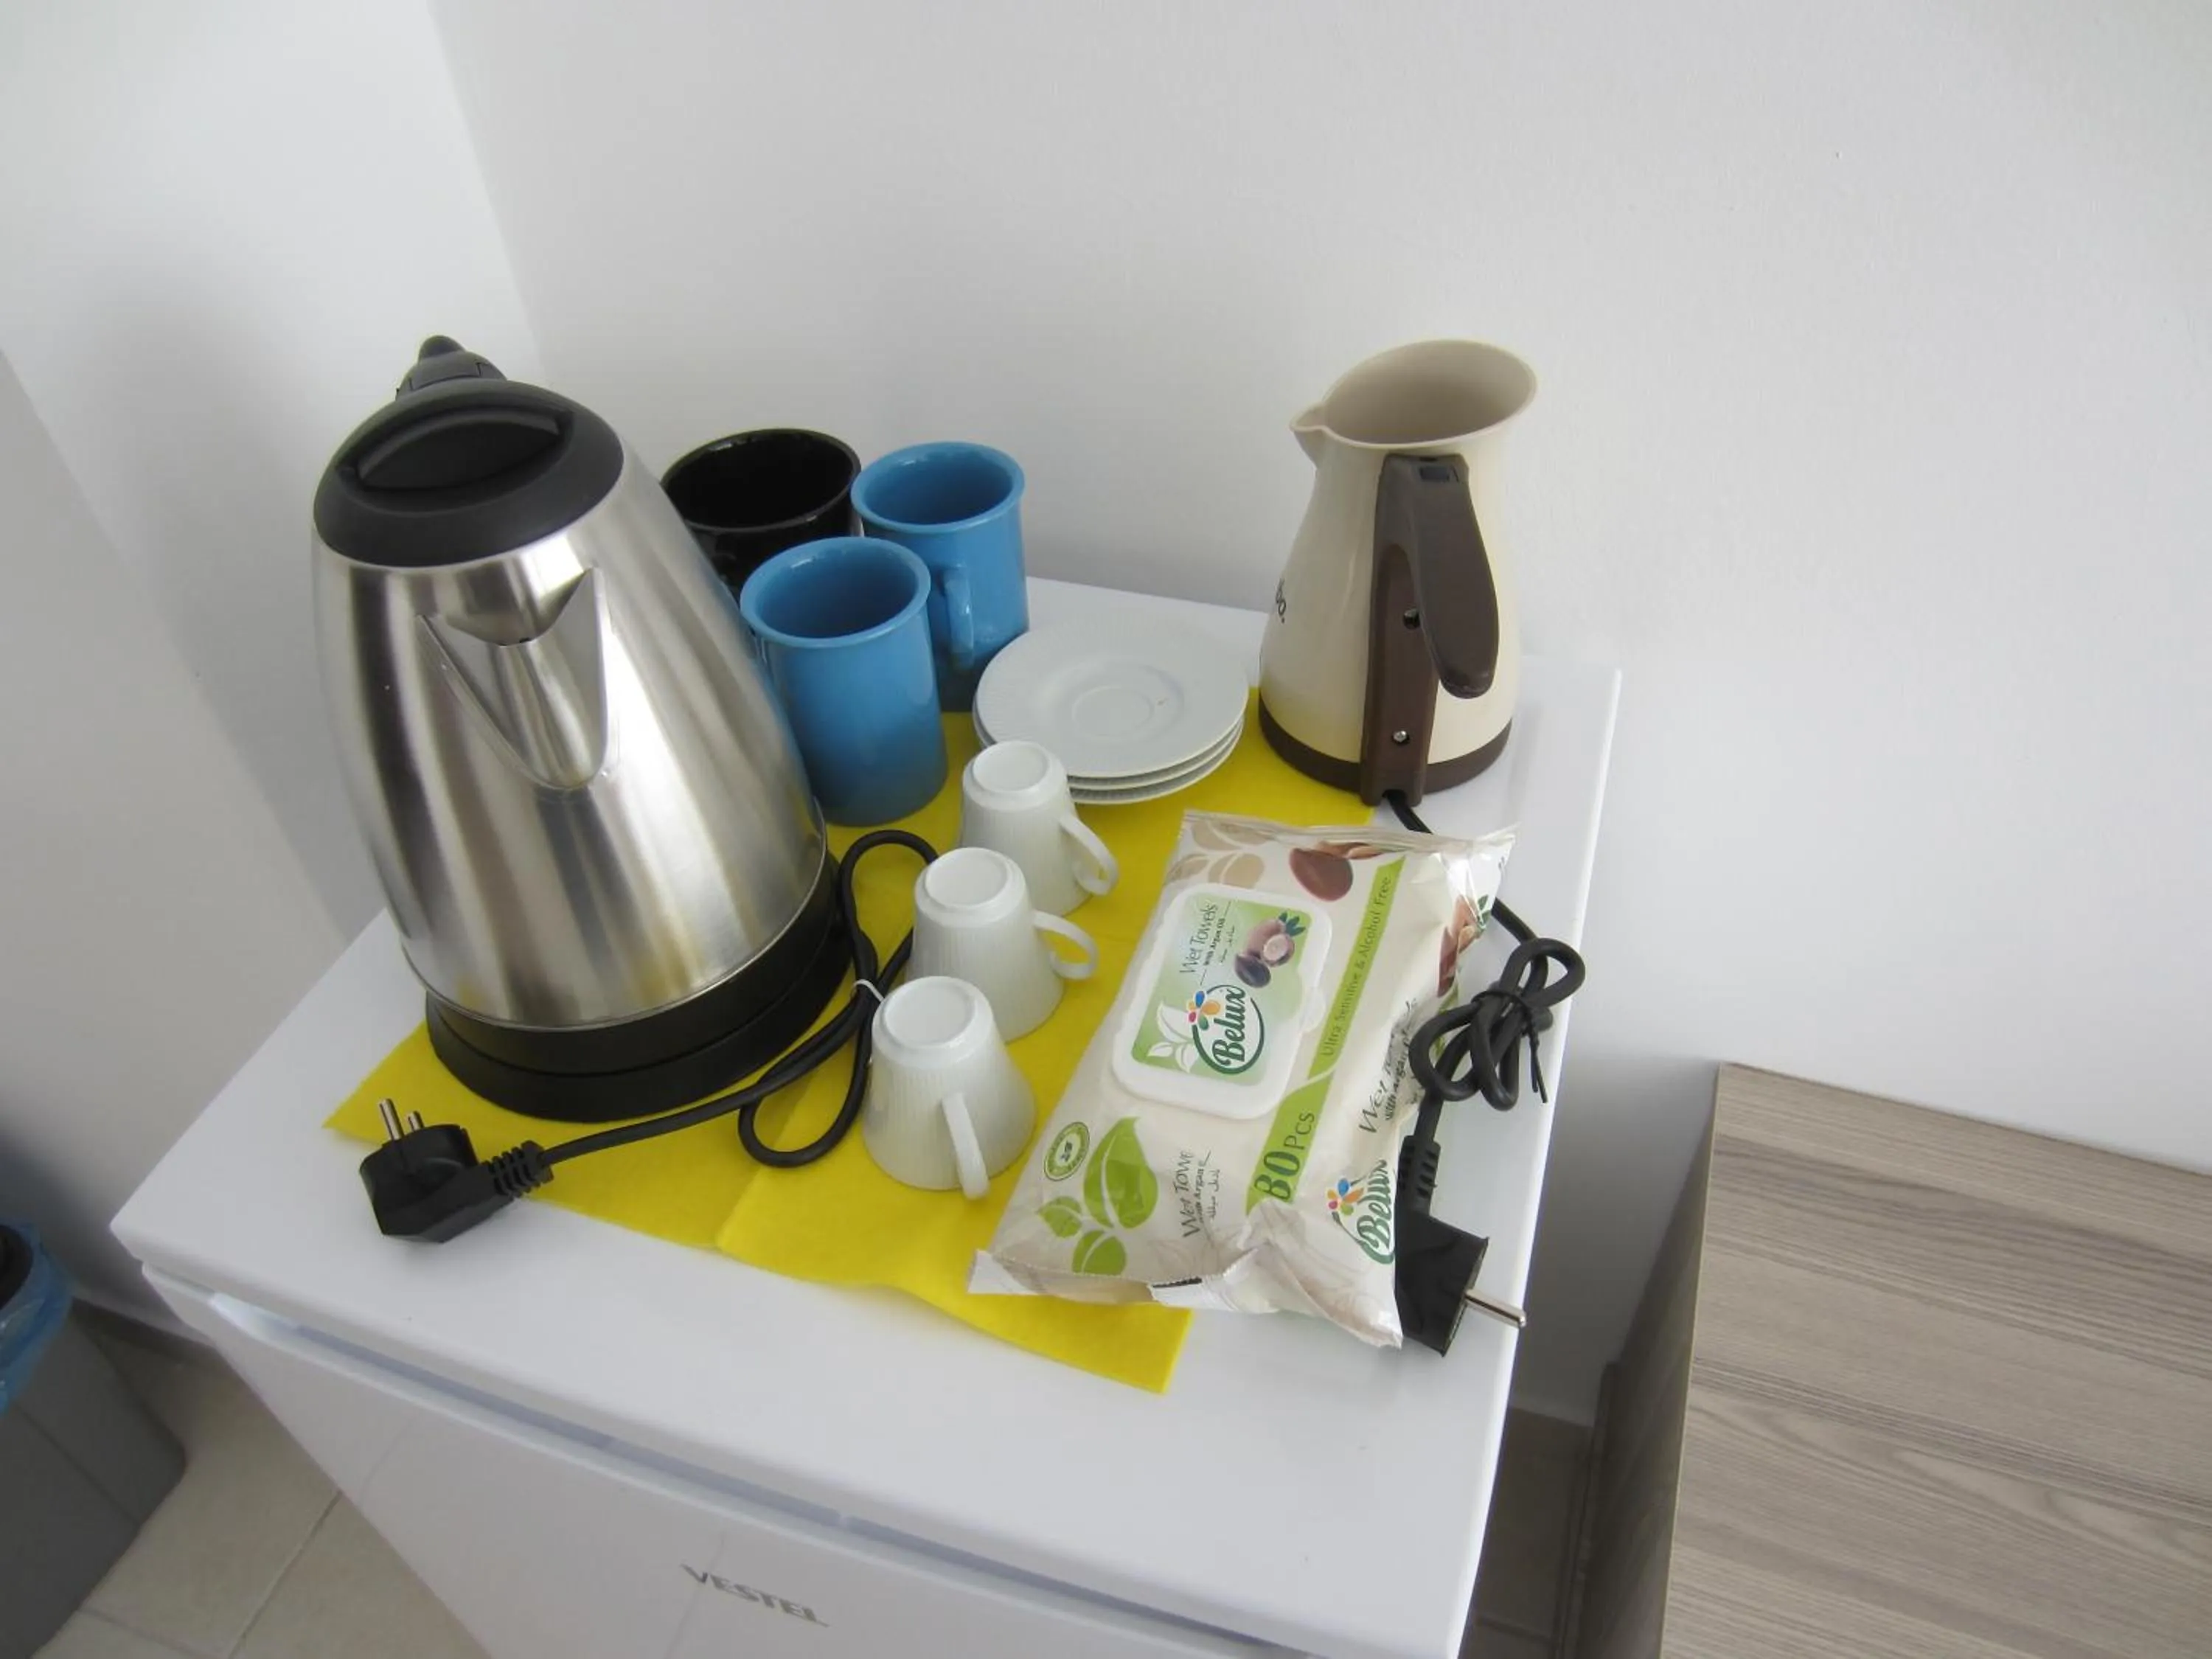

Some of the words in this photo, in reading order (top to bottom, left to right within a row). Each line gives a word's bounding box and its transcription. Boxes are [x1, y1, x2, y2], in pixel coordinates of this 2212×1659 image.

[1189, 902, 1218, 945] Towels
[1319, 1026, 1341, 1056] Ultra
[1357, 911, 1381, 958] Alcohol
[1373, 876, 1391, 906] Free
[1211, 988, 1245, 1066] Belux
[1358, 1079, 1389, 1133] Wet
[1253, 1151, 1301, 1202] 80
[1283, 1113, 1315, 1150] Pcs
[1180, 1197, 1200, 1238] Wet
[679, 1562, 830, 1628] VESTEL
